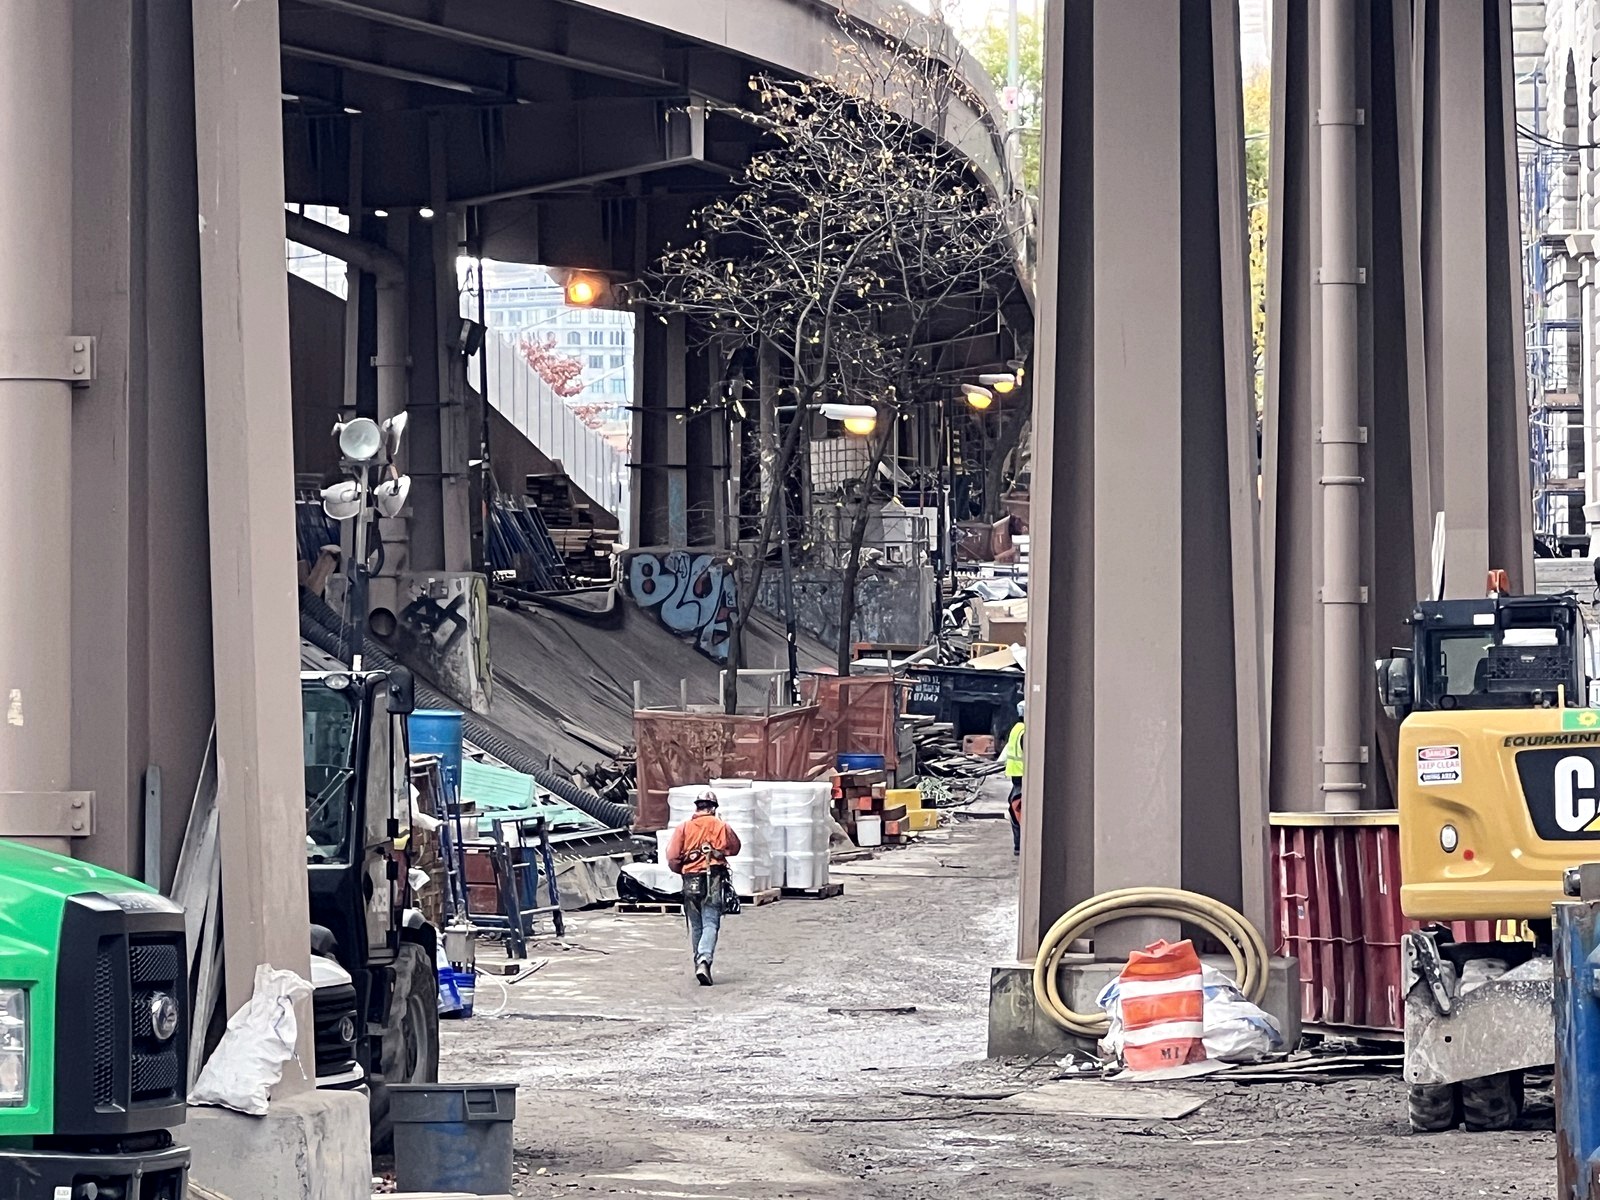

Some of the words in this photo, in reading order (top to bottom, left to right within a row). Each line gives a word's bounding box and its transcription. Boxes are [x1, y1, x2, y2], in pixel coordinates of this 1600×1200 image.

[1503, 732, 1600, 748] EQUIPMENT
[1436, 760, 1460, 769] CLEAR
[1554, 755, 1600, 832] C
